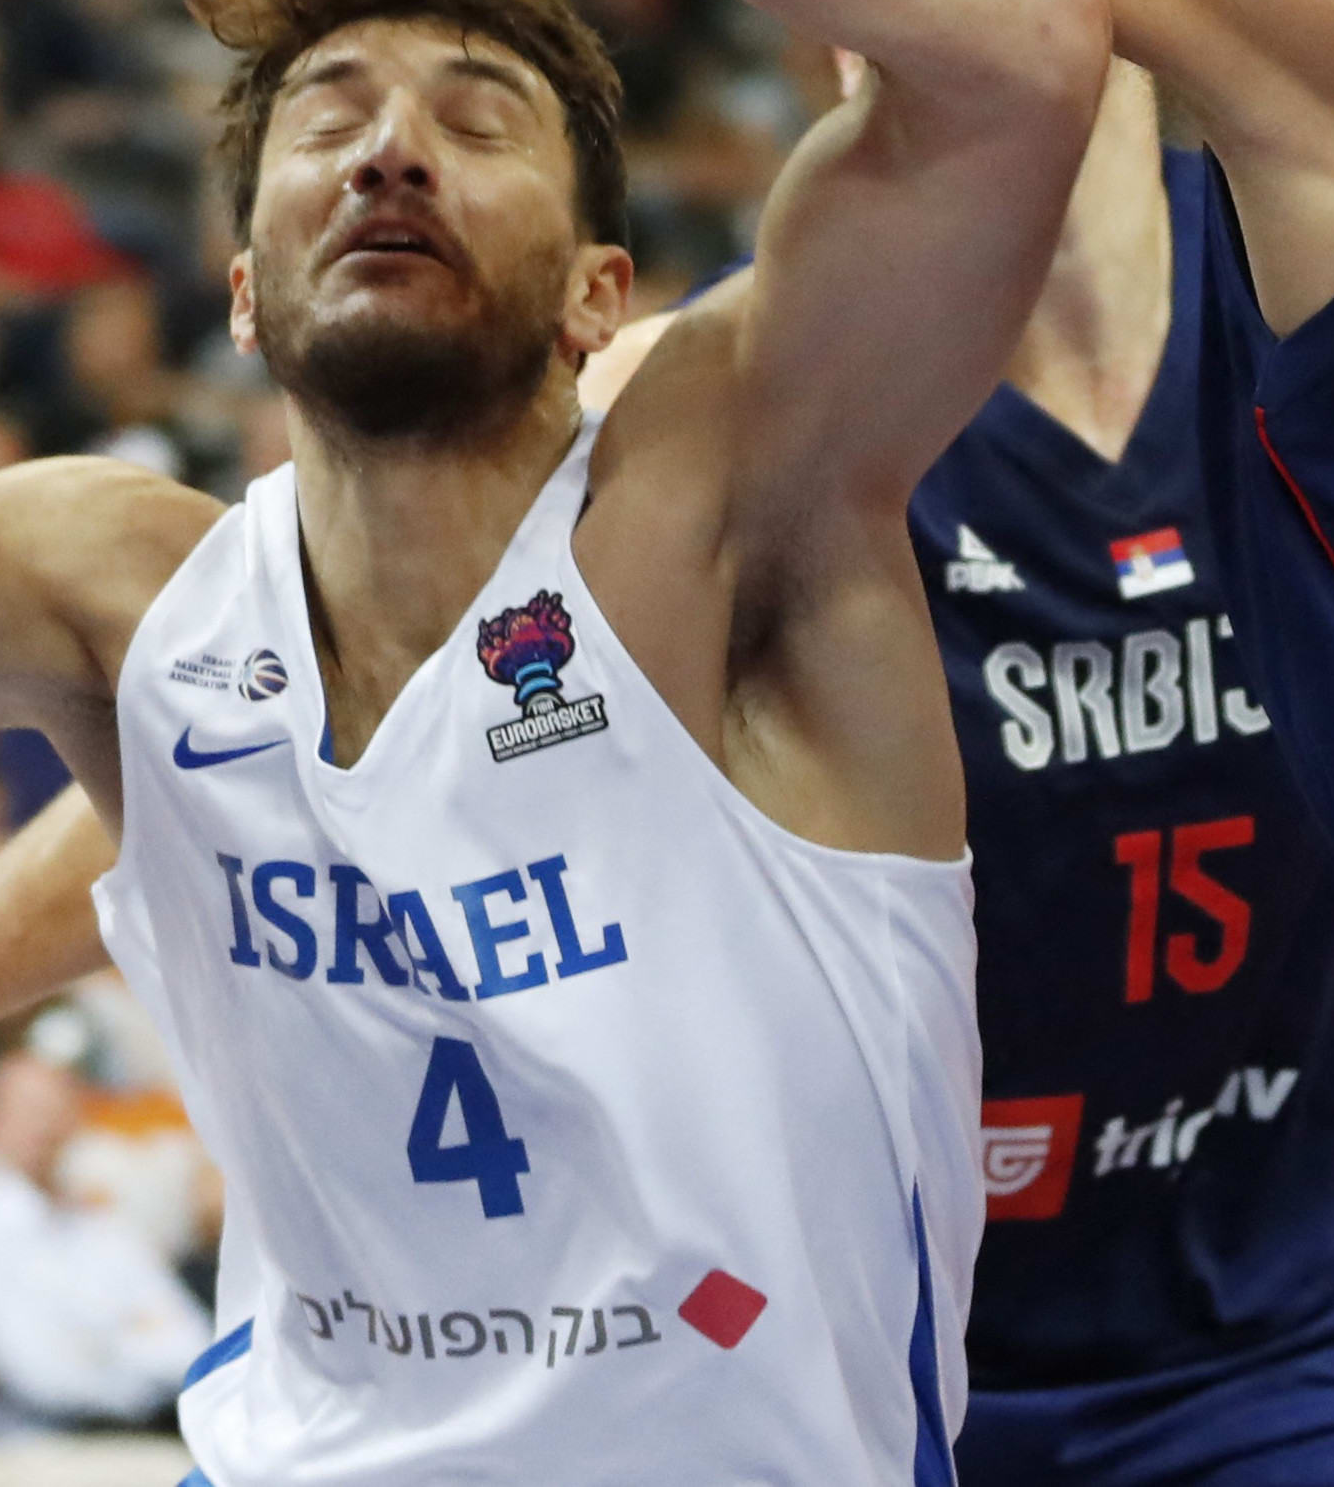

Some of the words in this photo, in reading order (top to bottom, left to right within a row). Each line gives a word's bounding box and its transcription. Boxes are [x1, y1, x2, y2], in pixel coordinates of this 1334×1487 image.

[489, 696, 604, 751] EUROBASKET
[216, 854, 629, 1002] ISRAEL
[1114, 816, 1255, 1002] 15
[407, 1036, 531, 1219] 4
[546, 1304, 662, 1369] בנק
